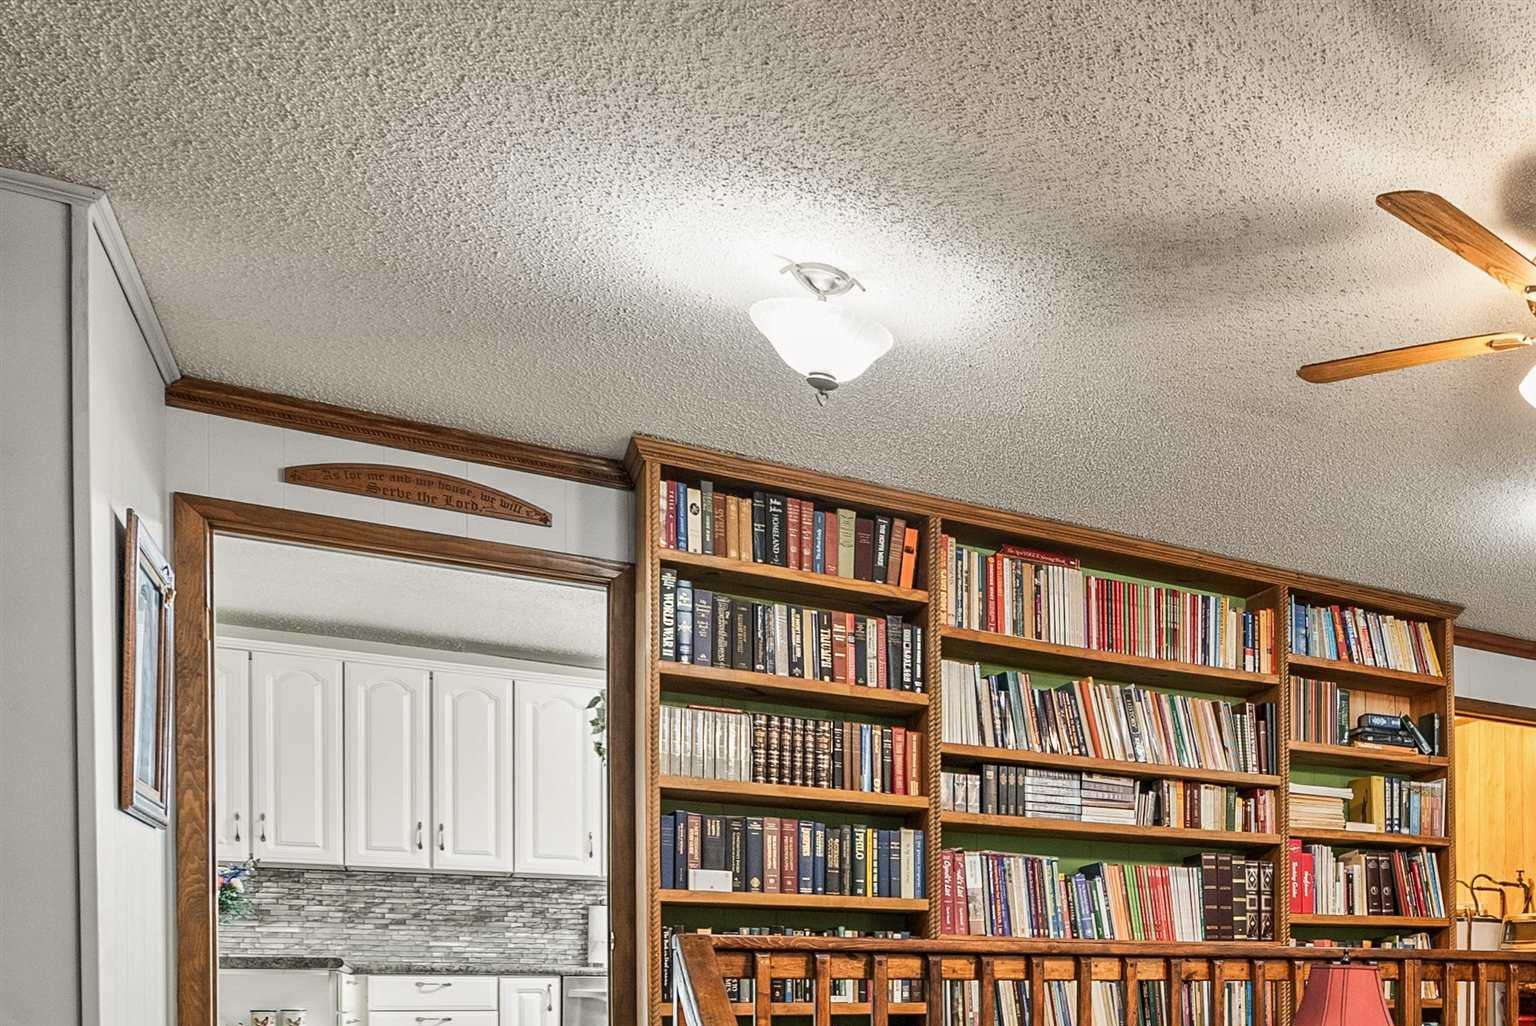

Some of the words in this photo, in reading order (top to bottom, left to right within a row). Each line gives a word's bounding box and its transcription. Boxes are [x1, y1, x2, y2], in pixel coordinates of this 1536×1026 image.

[320, 469, 341, 480] As
[342, 469, 361, 480] for
[368, 472, 385, 481] me
[389, 474, 413, 484] and
[416, 477, 434, 487] my
[437, 480, 476, 499] house,
[480, 493, 497, 504] we
[500, 500, 522, 514] will
[367, 481, 412, 500] Serve
[417, 491, 438, 504] the
[663, 592, 674, 626] WORLD
[663, 627, 674, 648] WAR
[820, 629, 831, 668] TRIUMPH
[663, 648, 674, 657] II
[855, 833, 865, 860] PHILO
